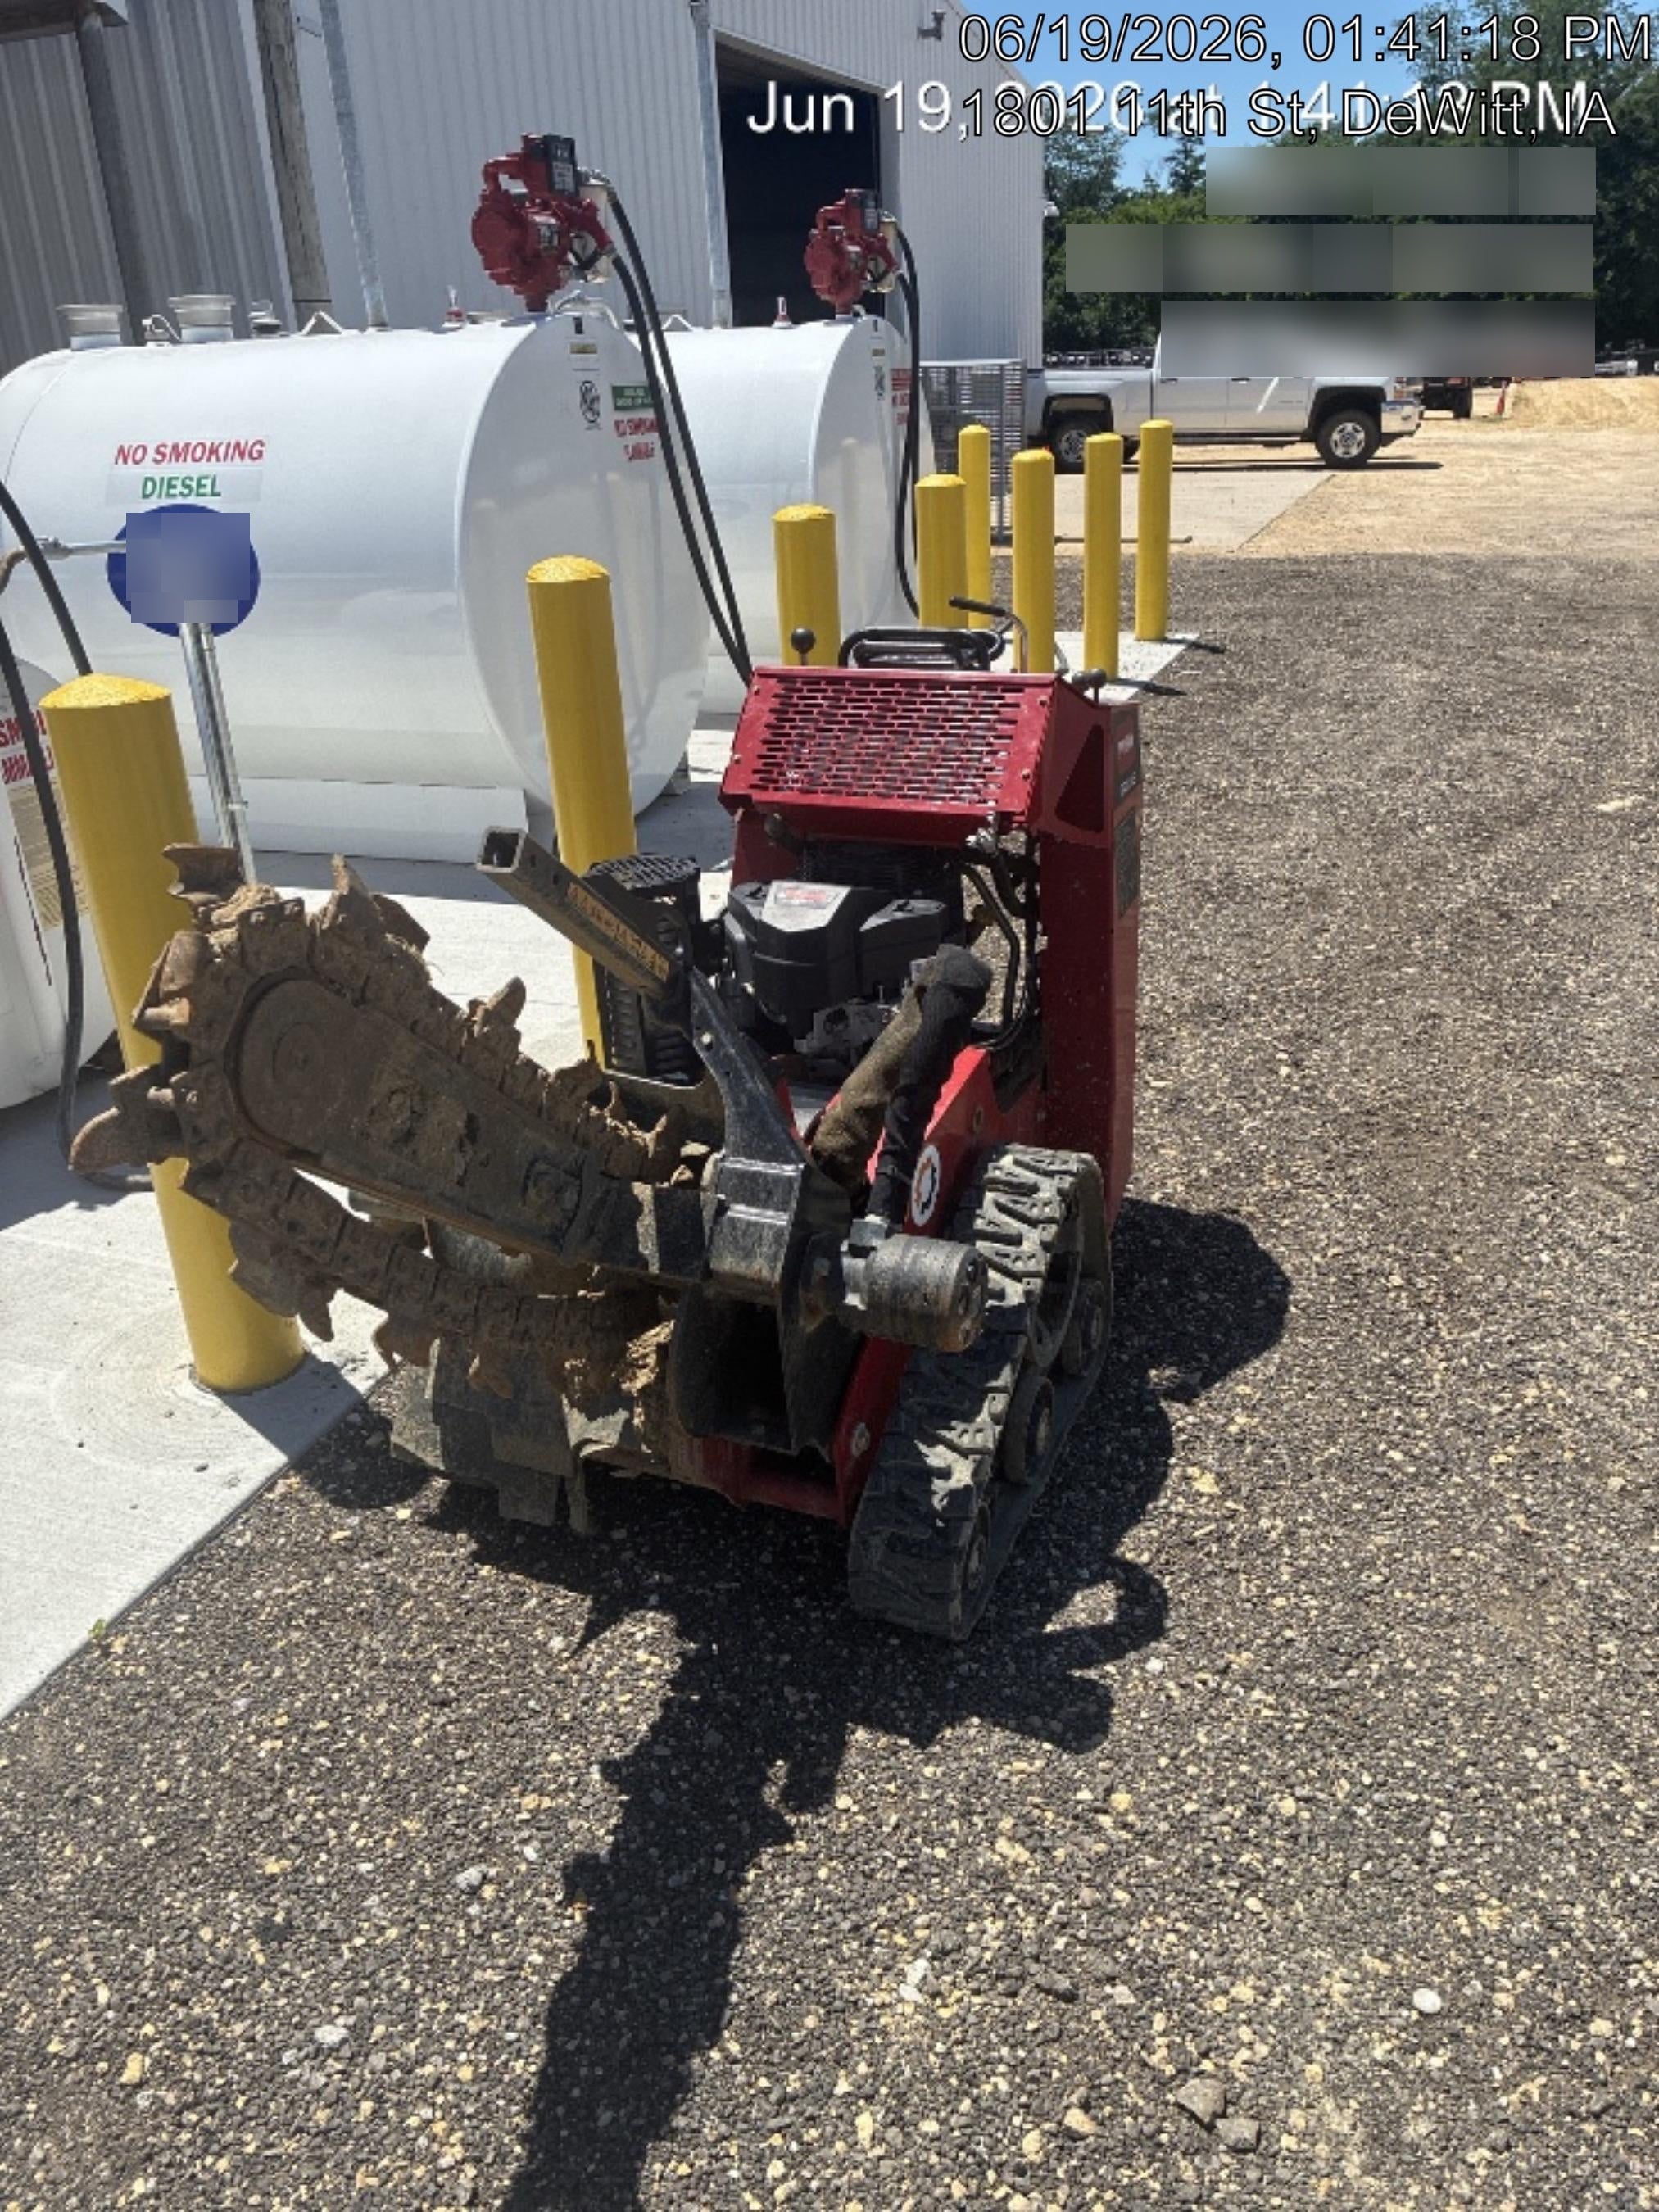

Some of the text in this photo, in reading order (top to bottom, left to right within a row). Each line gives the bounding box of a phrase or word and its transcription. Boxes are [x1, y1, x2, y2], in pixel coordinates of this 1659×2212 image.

[115, 439, 266, 465] NO SMOKING
[141, 474, 222, 500] DIESEL
